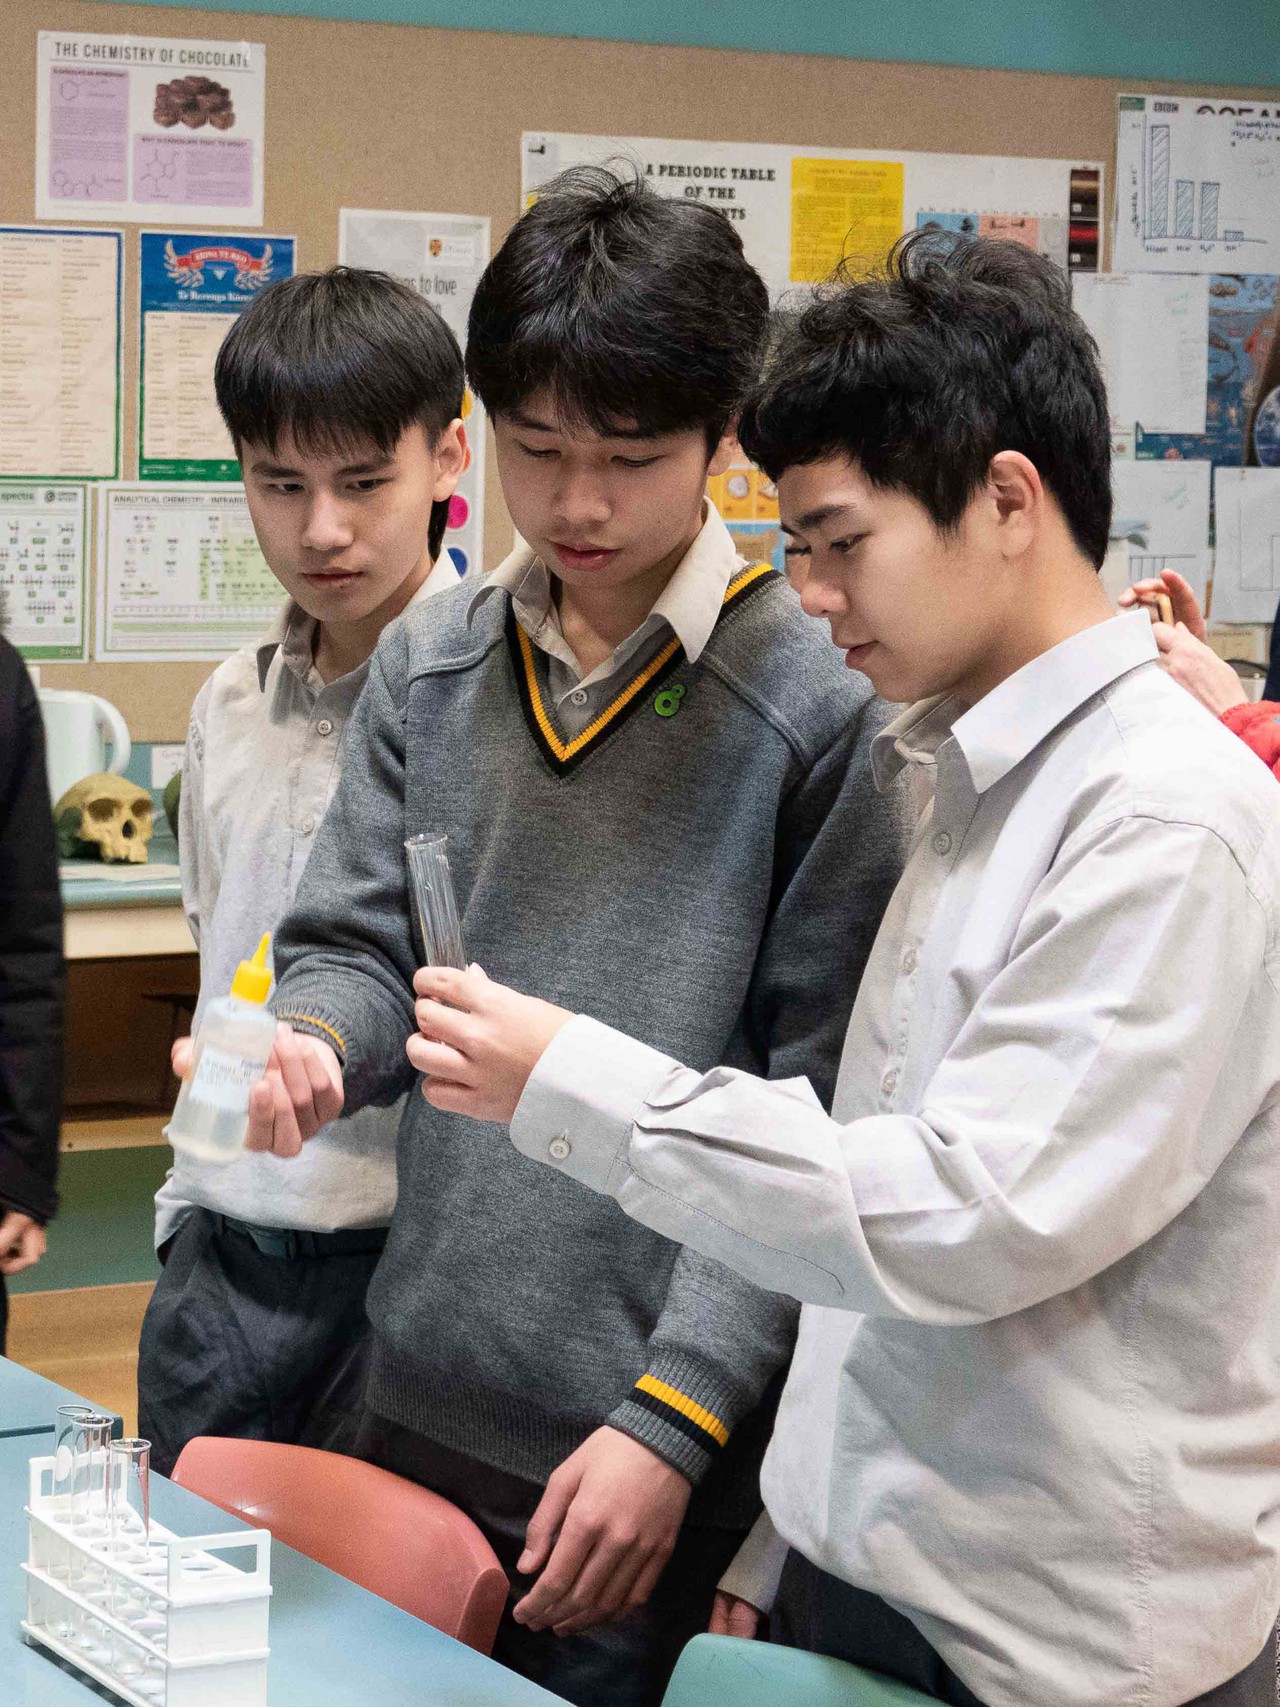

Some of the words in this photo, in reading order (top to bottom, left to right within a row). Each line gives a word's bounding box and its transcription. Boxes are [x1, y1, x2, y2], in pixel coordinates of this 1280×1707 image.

[55, 42, 78, 57] THE
[84, 44, 155, 62] CHEMISTRY
[160, 48, 174, 63] OF
[646, 164, 653, 176] A
[659, 164, 728, 179] PERIODIC
[731, 168, 776, 181] TABLE
[685, 185, 704, 198] OF
[708, 187, 736, 199] THE
[721, 207, 746, 220] NTS
[420, 274, 431, 295] to
[434, 275, 457, 296] love
[1, 492, 33, 501] spectra
[114, 495, 160, 504] ANALYTICAL
[162, 495, 204, 504] CHEMISTRY
